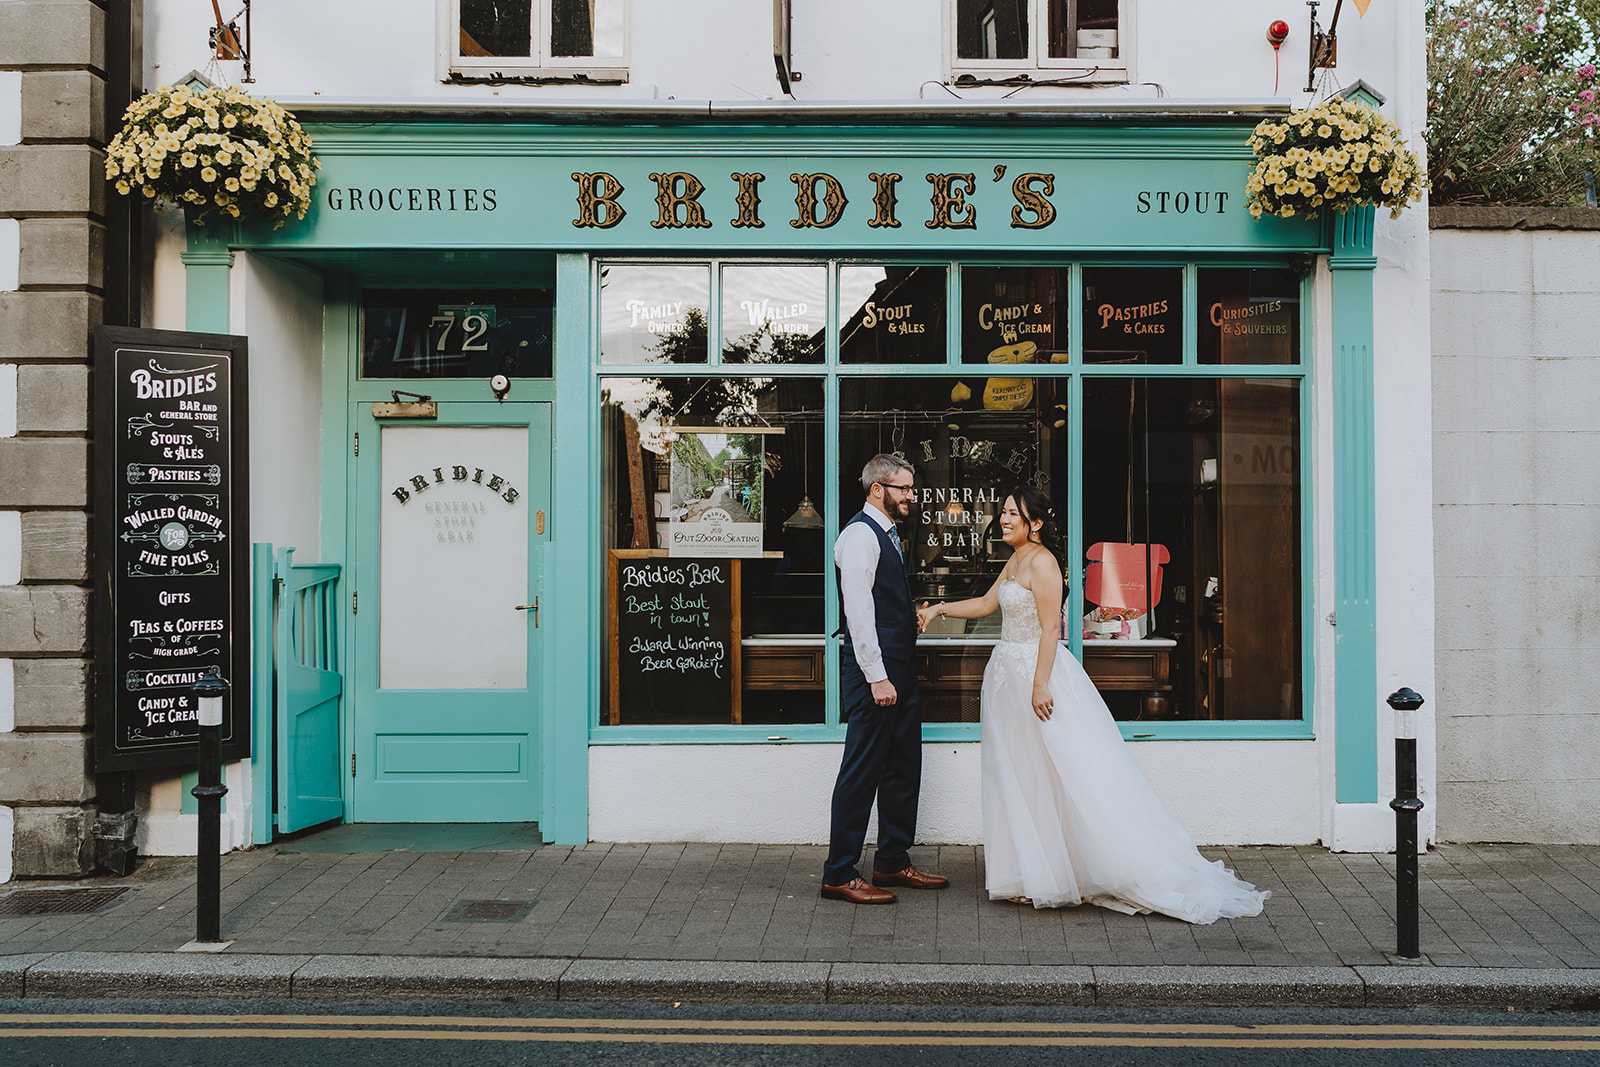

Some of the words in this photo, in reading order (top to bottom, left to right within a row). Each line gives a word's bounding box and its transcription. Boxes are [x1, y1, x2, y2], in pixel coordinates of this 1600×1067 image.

[328, 188, 498, 212] GROCERIES
[570, 165, 1057, 230] BRIDIE'S
[1136, 191, 1230, 215] STOUT
[625, 299, 683, 328] FAMILY
[740, 298, 808, 326] WALLED
[862, 301, 913, 329] STOUT
[978, 303, 1029, 331] CANDY
[1033, 304, 1043, 315] &
[1097, 300, 1169, 330] PASTRIES
[1210, 300, 1282, 327] CURIOSITIES
[428, 314, 489, 351] 72
[648, 321, 684, 334] OWNED
[768, 321, 809, 335] GARDEN
[888, 323, 897, 334] &
[898, 321, 925, 335] ALES
[998, 322, 1016, 336] ICE
[1018, 322, 1052, 334] CREAM
[1123, 324, 1133, 334] &
[1134, 322, 1166, 335] CAKES
[1223, 323, 1232, 335] &
[1234, 322, 1288, 336] SOUVENIRS
[130, 368, 217, 399] BRIDIES
[180, 401, 201, 411] BAR
[202, 404, 218, 412] AND
[160, 411, 193, 420] GENERAL
[194, 412, 218, 421] STORE
[150, 431, 194, 446] STOUTS
[163, 447, 173, 459] &
[175, 446, 204, 460] ALES
[148, 467, 201, 482] PASTRIES
[392, 464, 520, 504] BRIDIE'S
[123, 507, 176, 529] WALLED
[177, 505, 223, 529] GARDEN
[922, 510, 985, 525] STORE
[164, 528, 185, 542] FOR
[722, 532, 760, 543] SEATING
[139, 550, 167, 567] FINE
[171, 549, 209, 567] FOLKS
[159, 591, 191, 606] GIFTS
[625, 593, 663, 614] Best
[670, 593, 710, 610] Stout
[129, 620, 160, 637] TEAS
[163, 621, 174, 632] &
[176, 618, 224, 633] COFFEES
[650, 612, 662, 629] in
[171, 635, 182, 643] OF
[153, 647, 172, 656] HIGH
[173, 646, 198, 656] GRADE
[138, 696, 176, 711] CANDY
[178, 696, 188, 707] &
[145, 711, 165, 727] ICE
